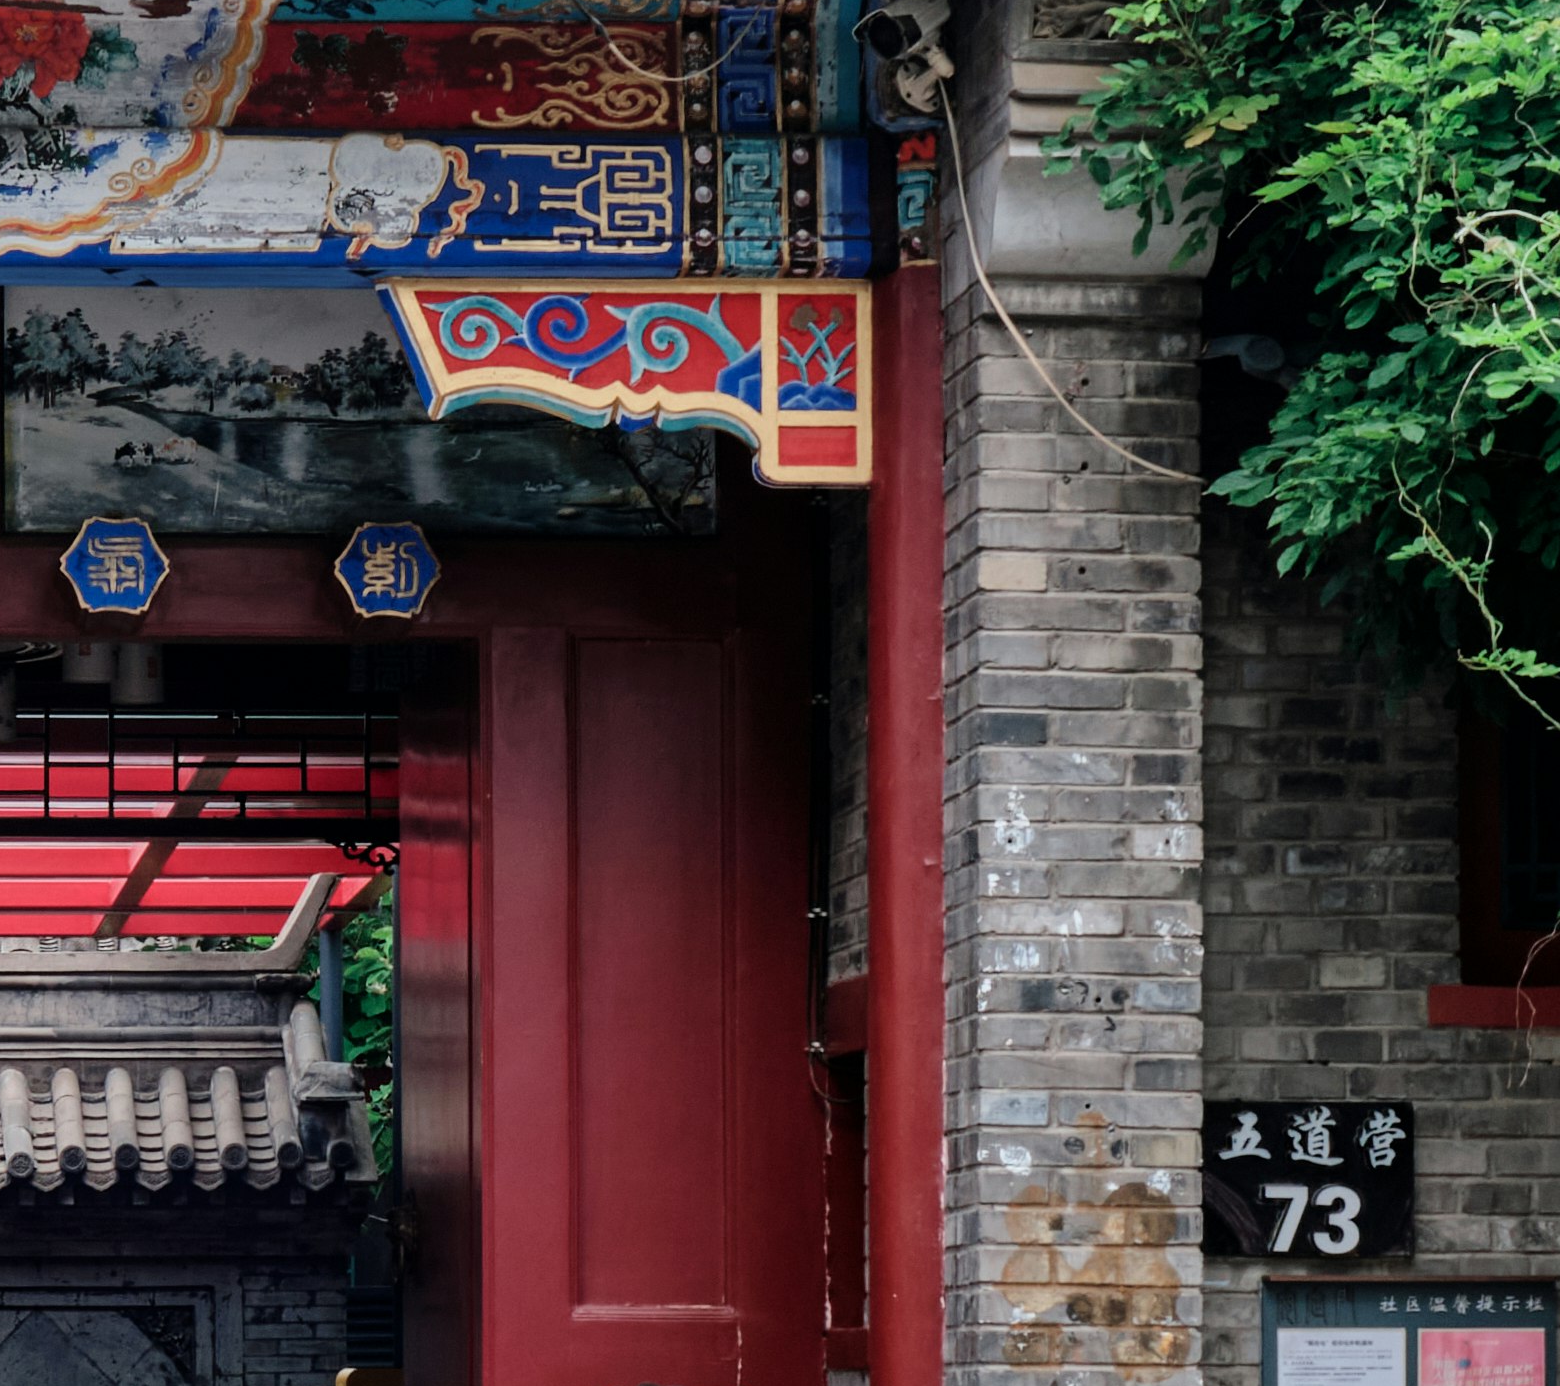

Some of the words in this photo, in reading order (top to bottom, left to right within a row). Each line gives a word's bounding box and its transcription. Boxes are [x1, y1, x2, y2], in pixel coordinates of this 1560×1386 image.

[1218, 1106, 1407, 1168] 五道营
[1264, 1184, 1362, 1255] 73
[1379, 1294, 1546, 1314] 社区温馨提示栏
